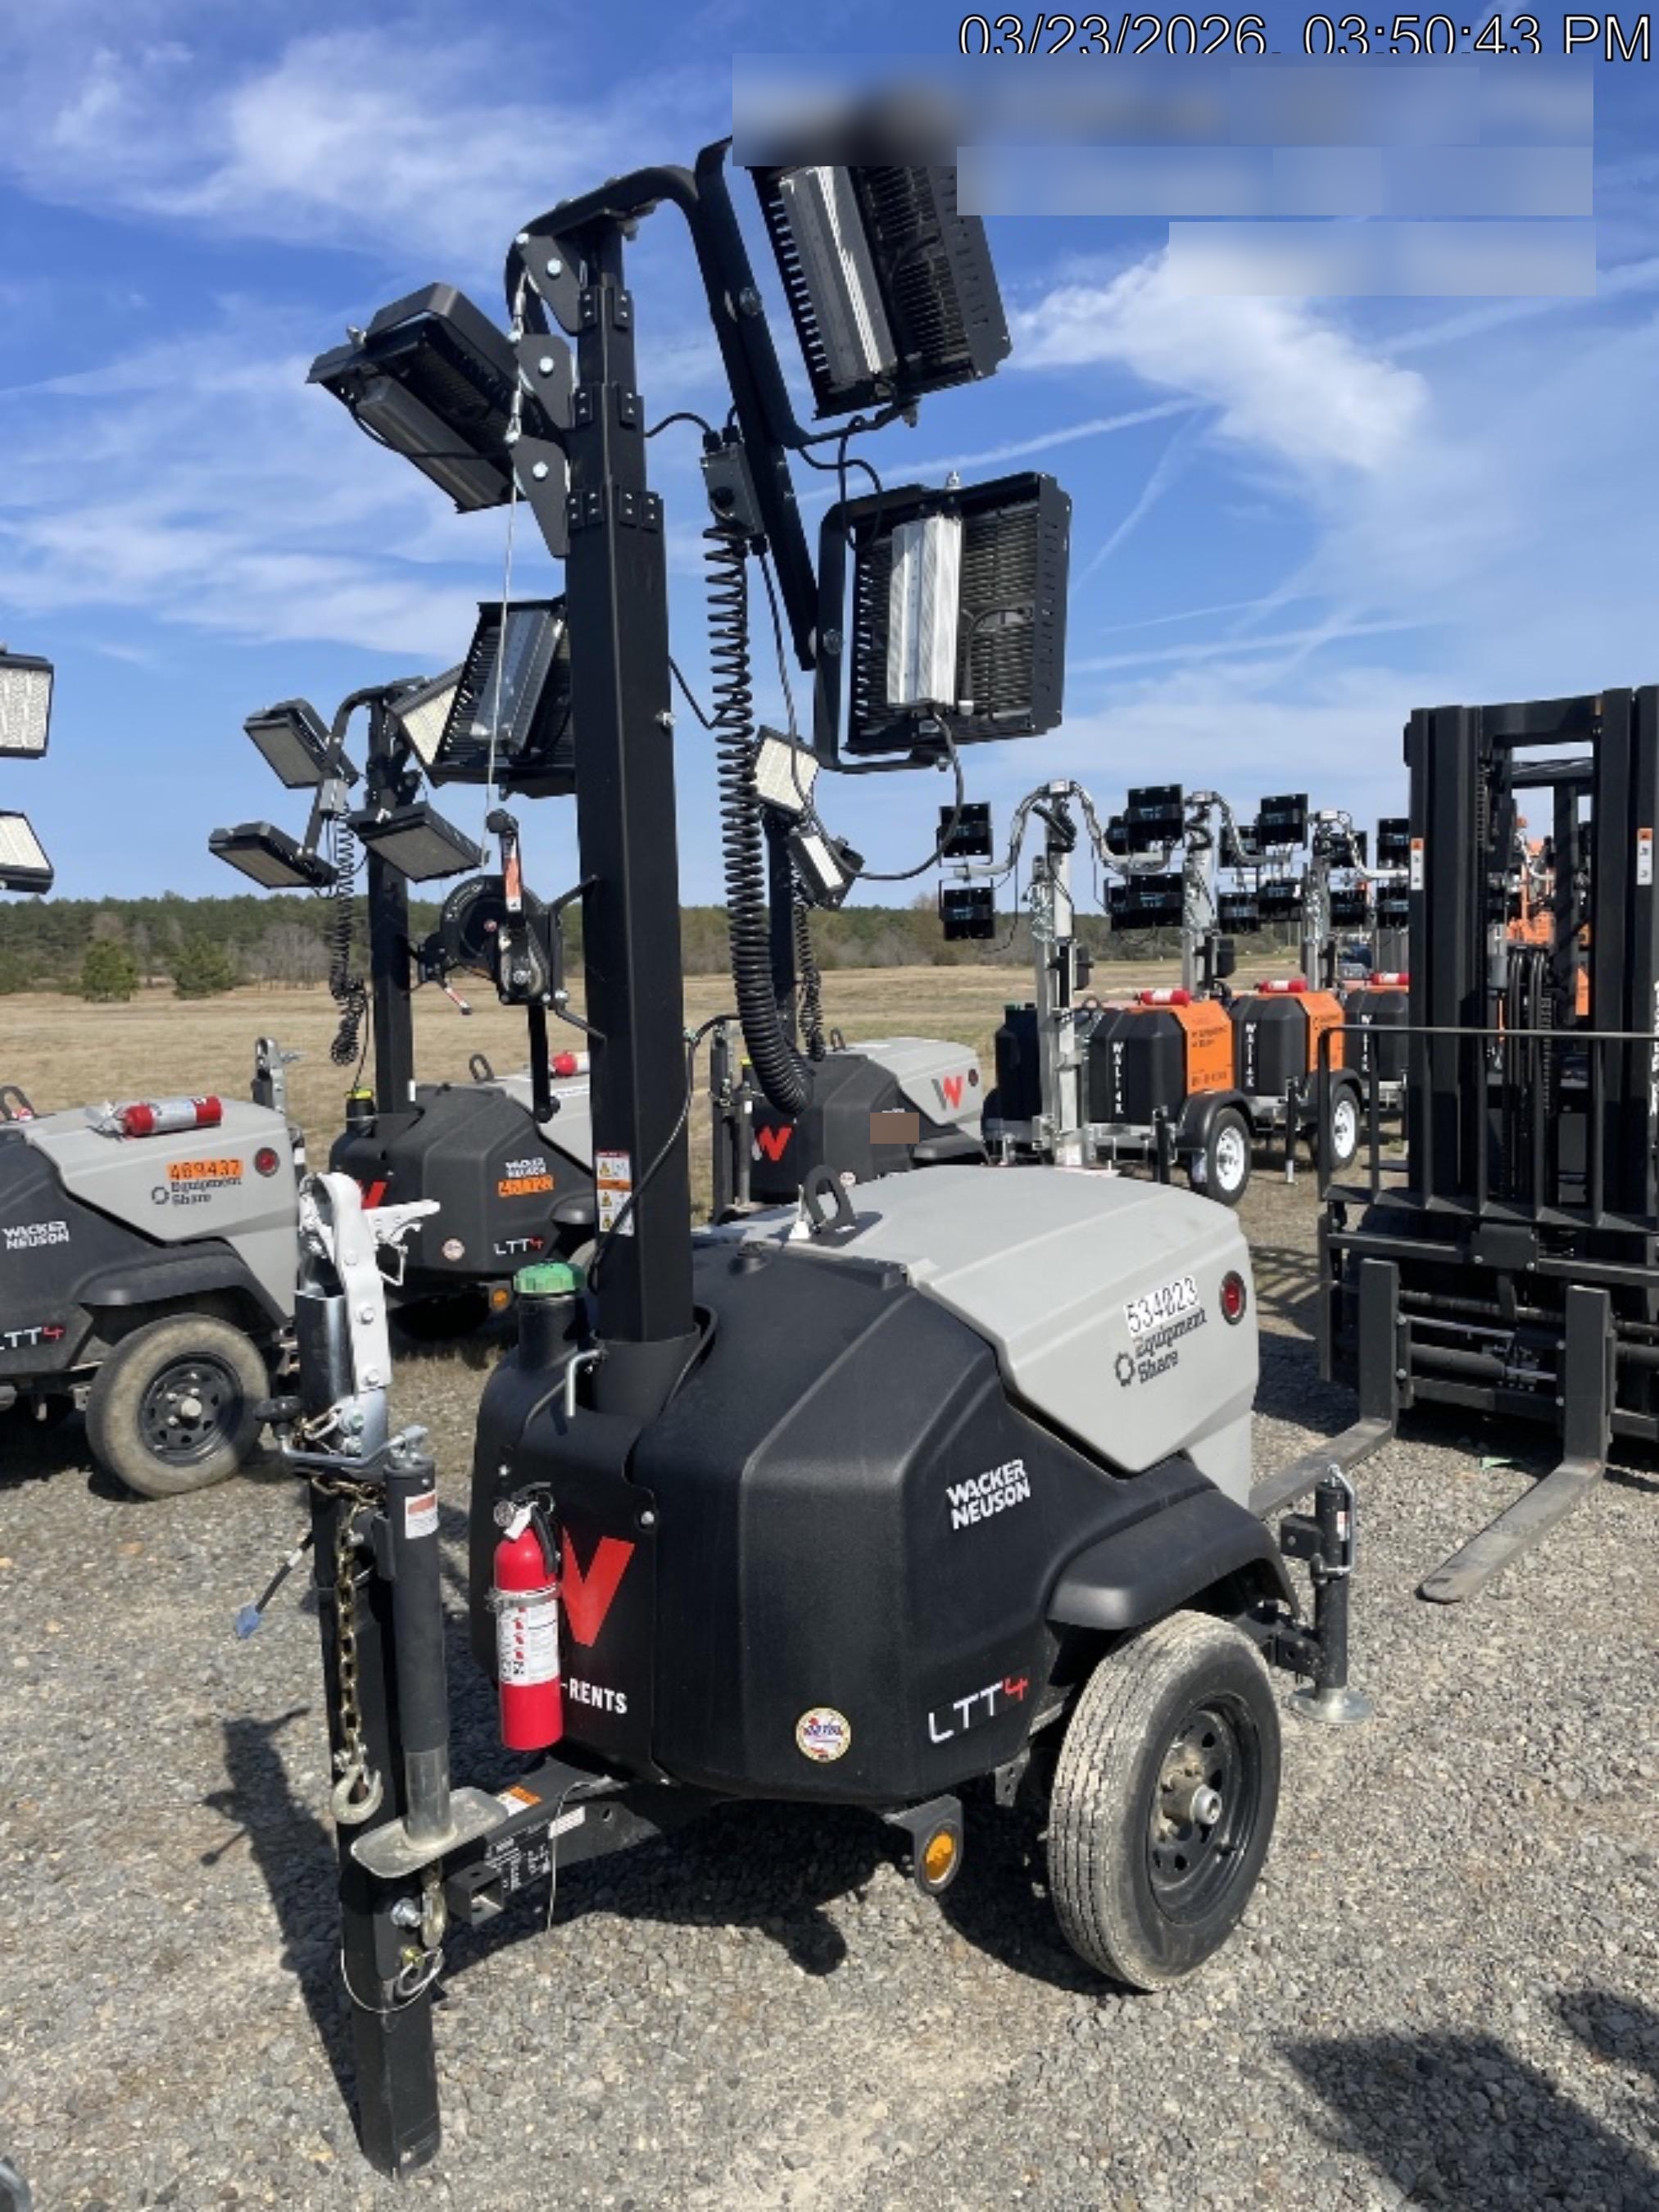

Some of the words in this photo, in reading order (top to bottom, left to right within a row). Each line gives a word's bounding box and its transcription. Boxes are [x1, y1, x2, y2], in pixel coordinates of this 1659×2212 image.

[0, 1326, 65, 1350] TT4
[1137, 1350, 1179, 1384] Share
[945, 1458, 1027, 1507] WACKER
[951, 1476, 1031, 1530] NEUSON
[927, 1676, 1030, 1743] LTT4
